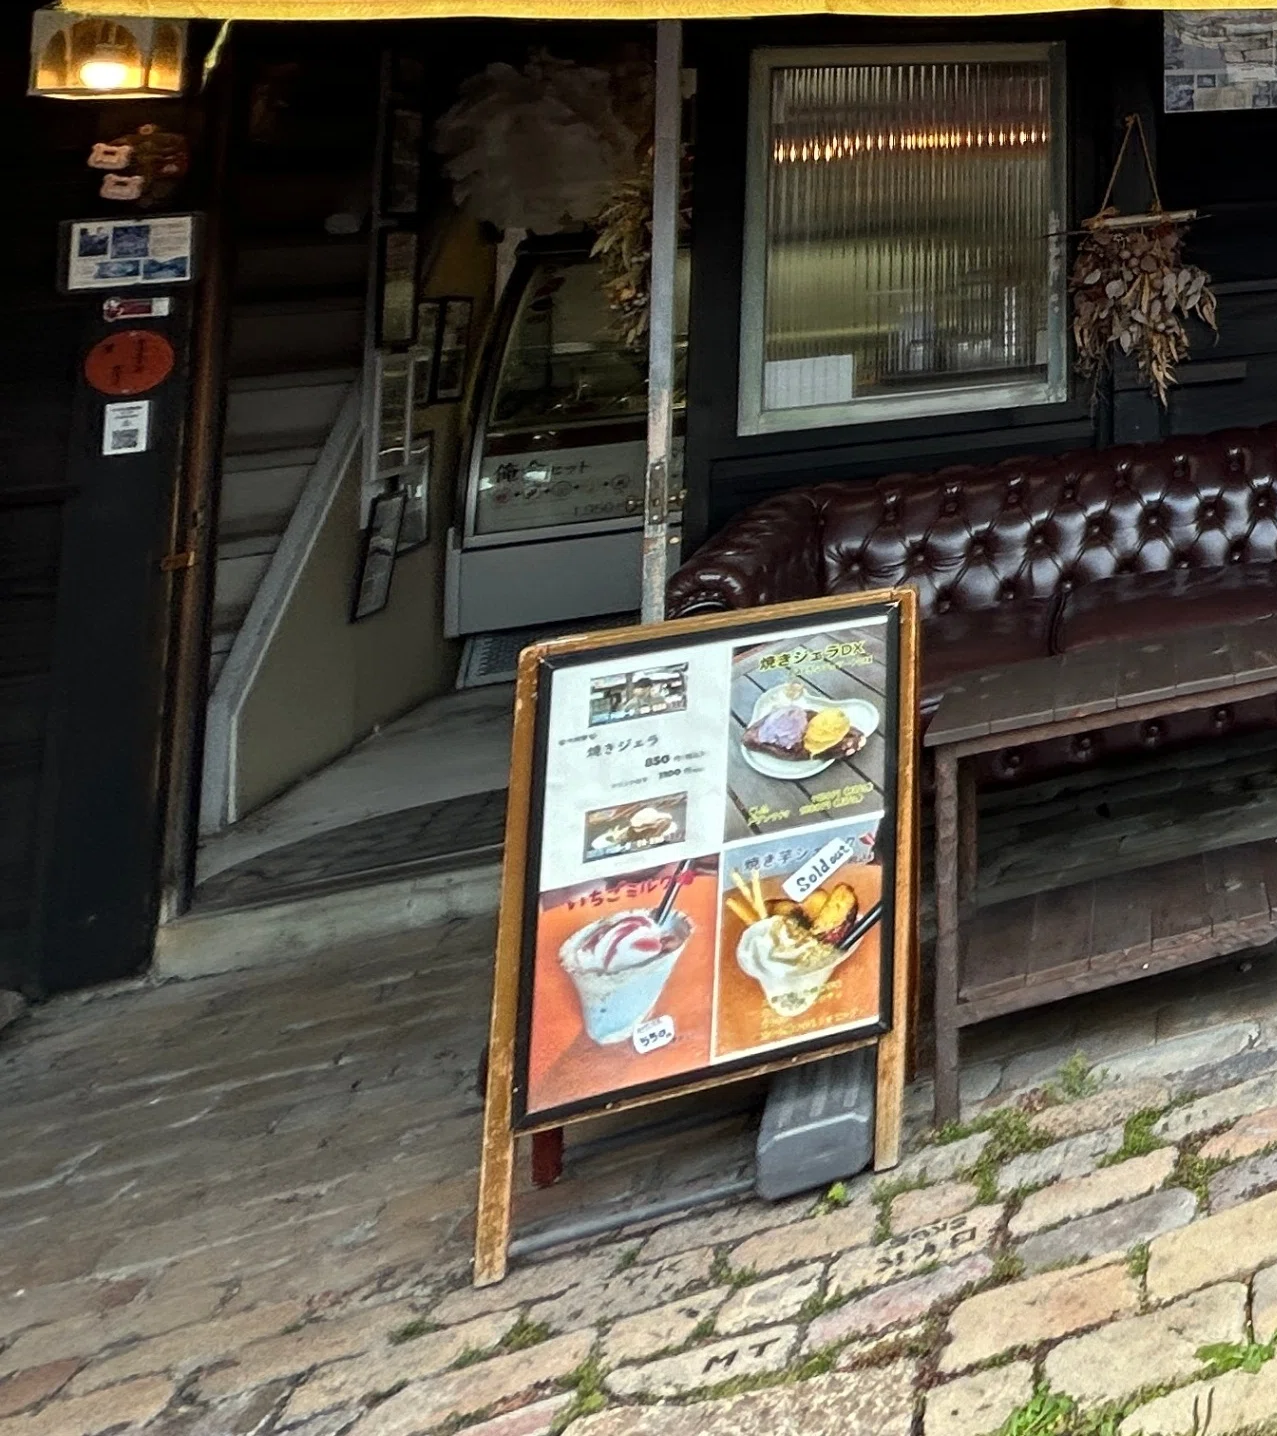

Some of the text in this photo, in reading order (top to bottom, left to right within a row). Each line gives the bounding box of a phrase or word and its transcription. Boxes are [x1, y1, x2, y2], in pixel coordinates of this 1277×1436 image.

[760, 641, 866, 671] 焼きジェラDX
[586, 733, 660, 759] 焼きジェラ
[644, 754, 671, 768] 850
[796, 857, 831, 893] Sold
